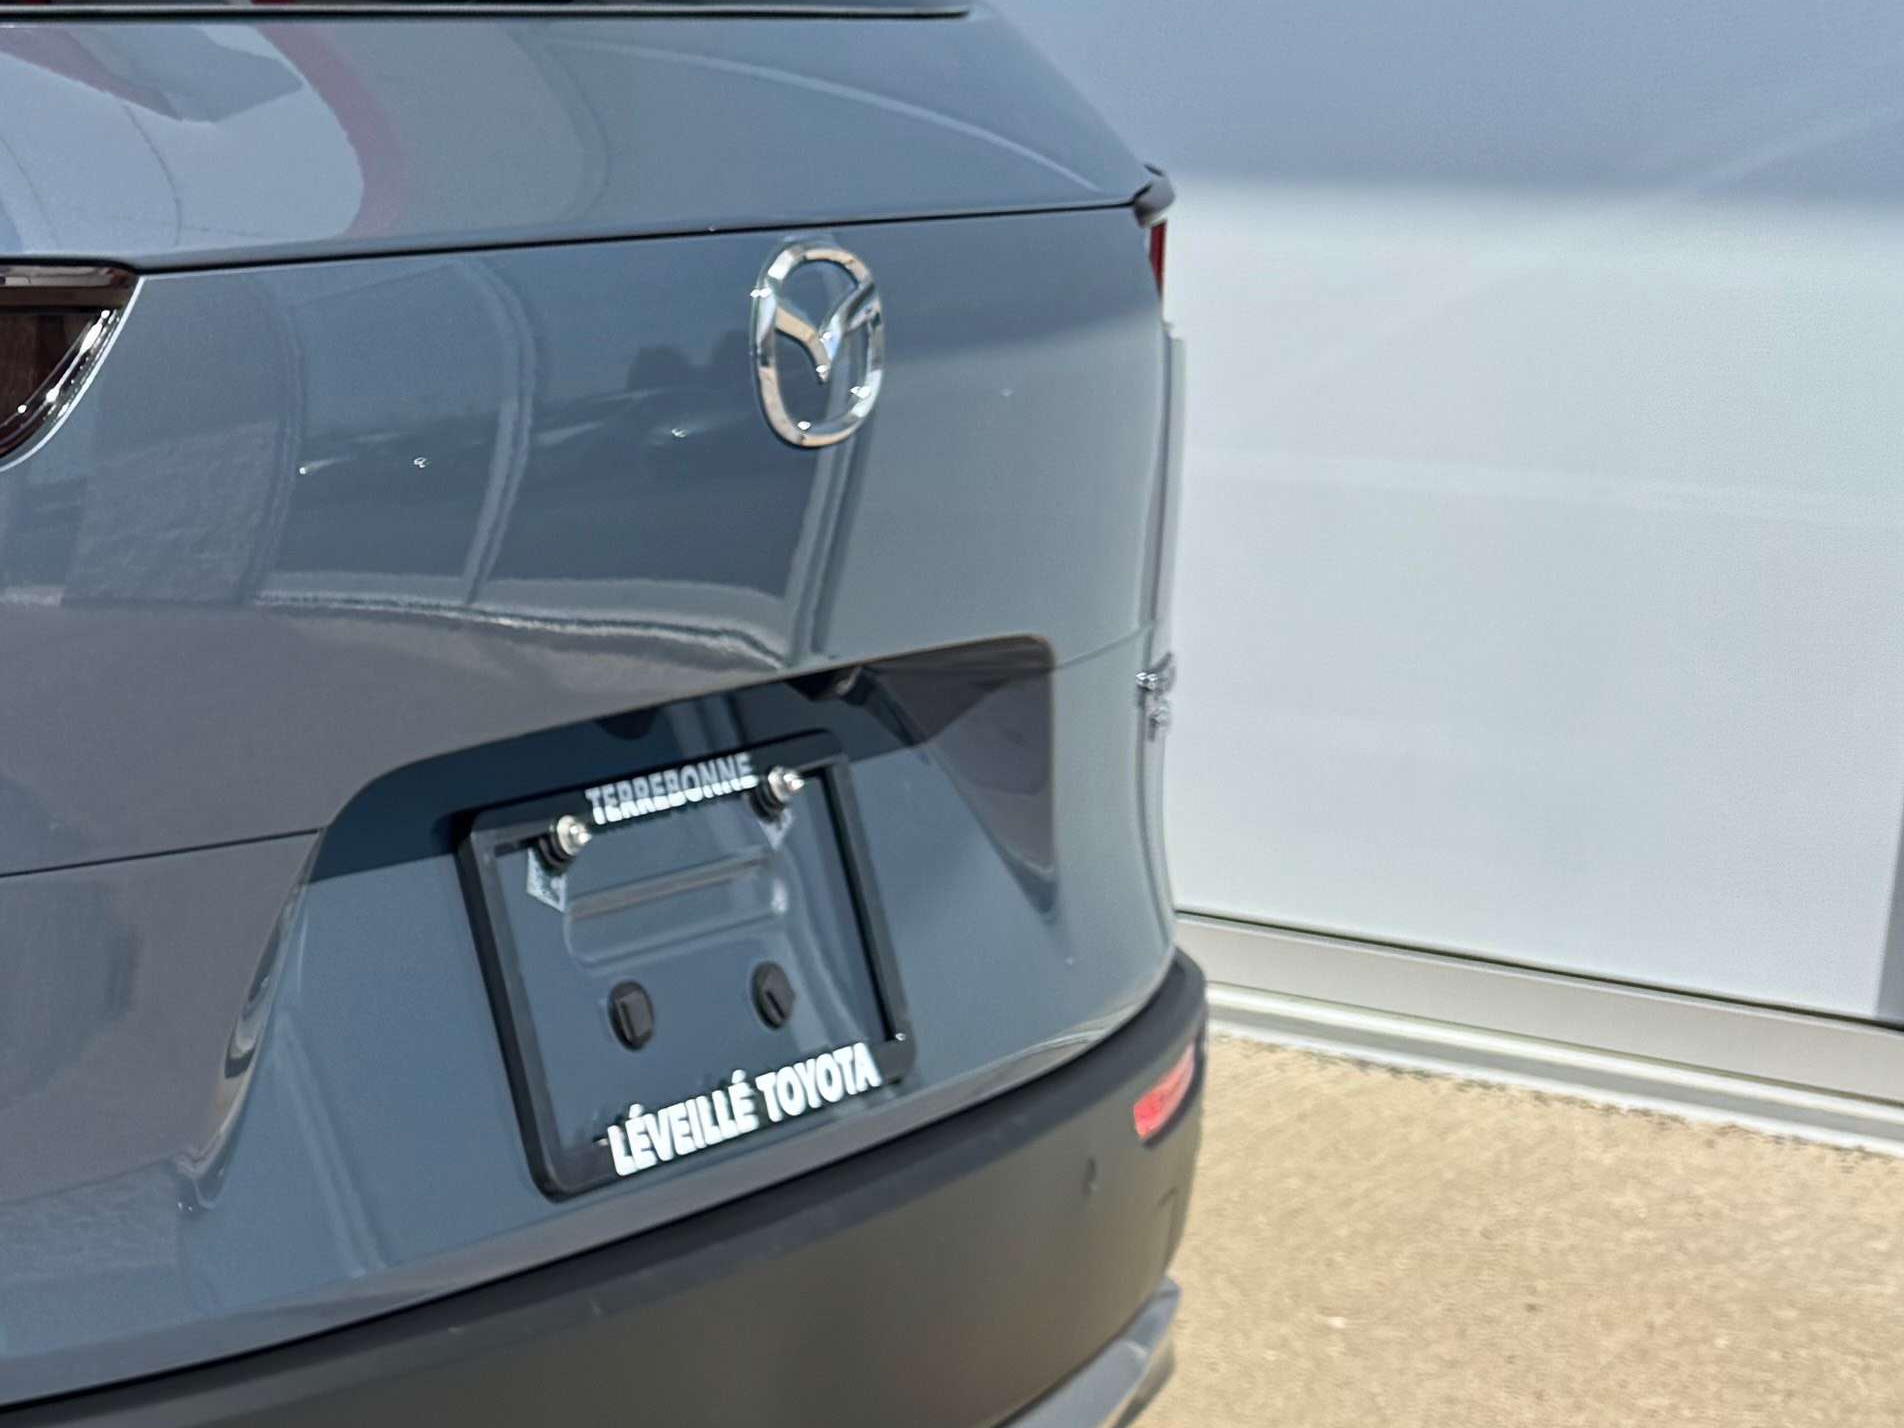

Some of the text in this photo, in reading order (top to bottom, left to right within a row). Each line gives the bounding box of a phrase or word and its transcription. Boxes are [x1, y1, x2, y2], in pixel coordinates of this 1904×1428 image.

[584, 751, 760, 826] TERREBONNE
[606, 1041, 883, 1177] LÉVEILLÉ TOYOTA
